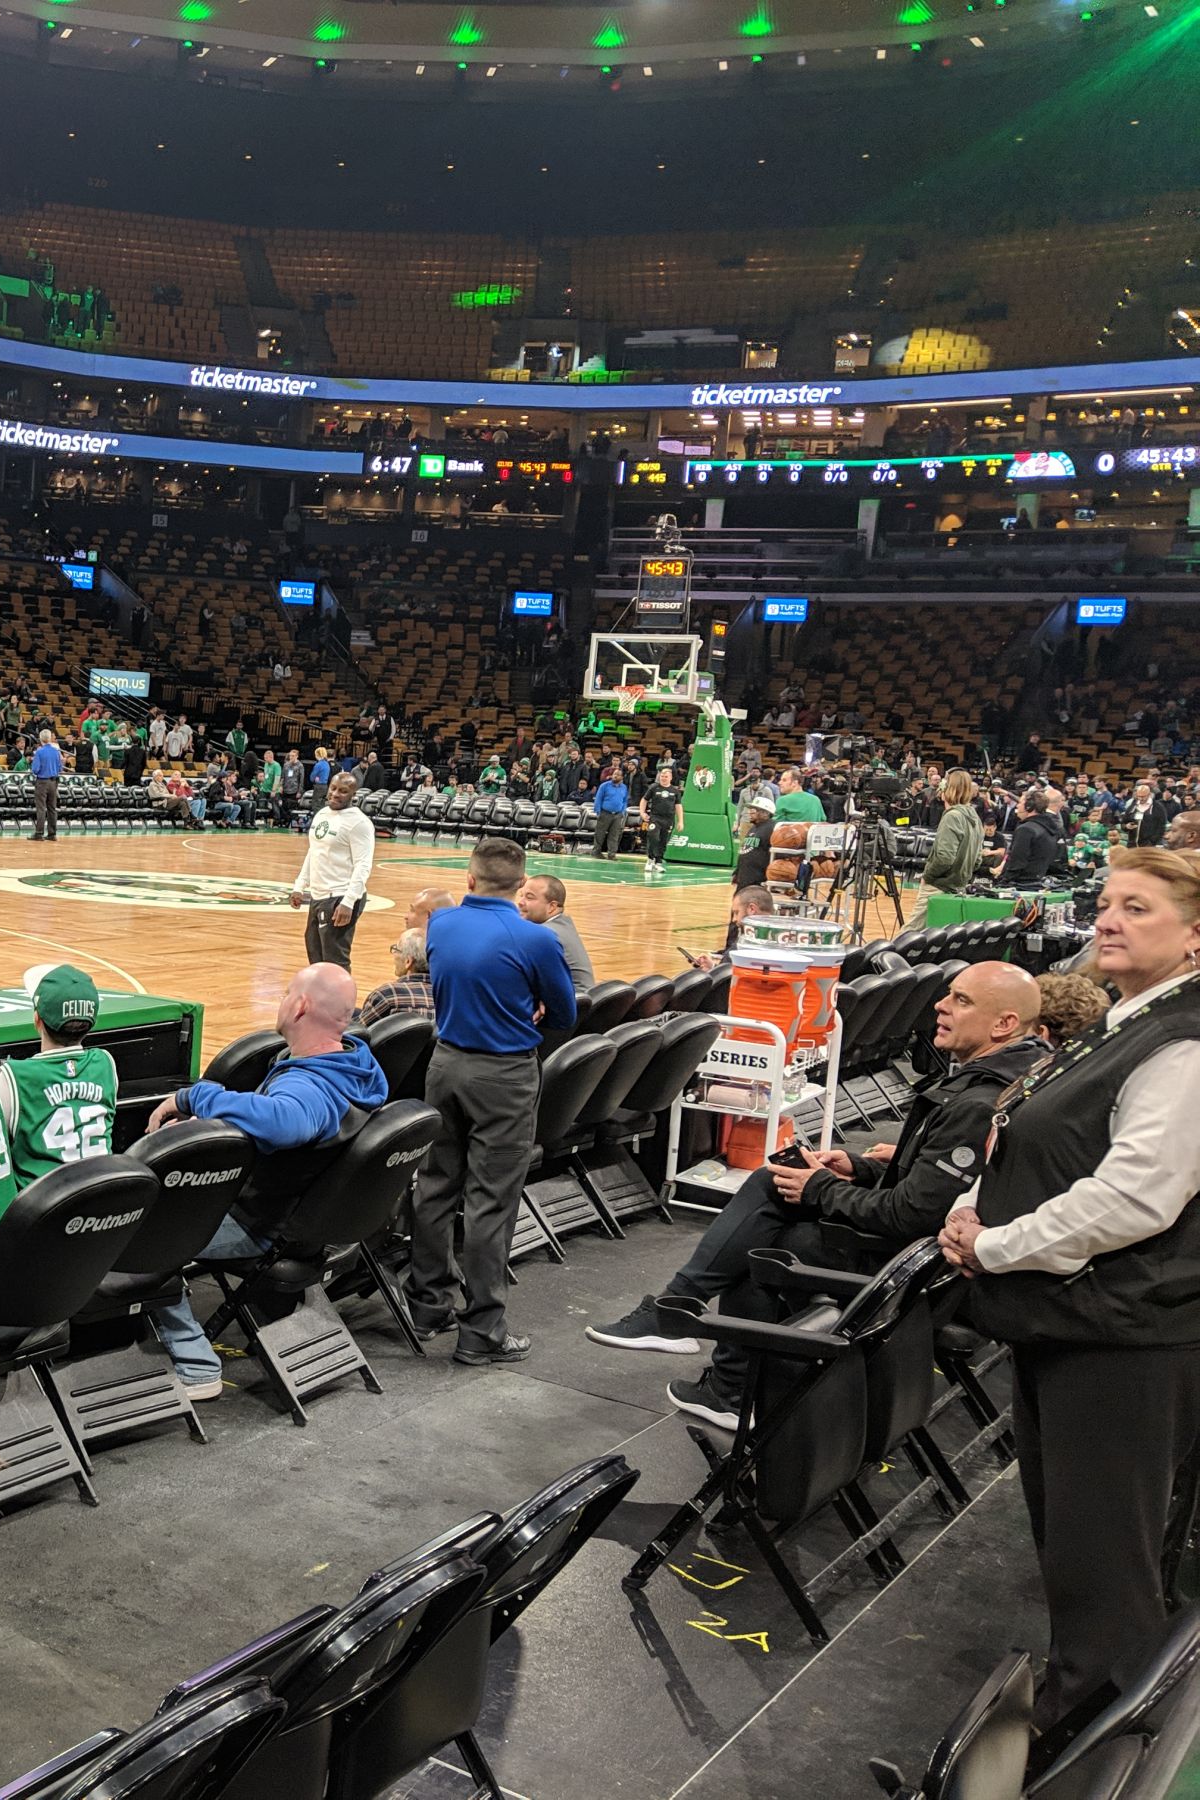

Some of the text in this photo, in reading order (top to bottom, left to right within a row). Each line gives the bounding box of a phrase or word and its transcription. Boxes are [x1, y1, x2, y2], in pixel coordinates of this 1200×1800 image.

[190, 366, 310, 396] ticketmaster
[691, 384, 833, 405] ticketmaster
[371, 455, 412, 473] 6:47
[1098, 454, 1115, 472] 0
[1137, 448, 1196, 463] 45:43
[423, 458, 441, 473] TD
[447, 459, 484, 472] Bank
[519, 462, 546, 473] 45:43
[698, 472, 706, 482] 0
[728, 472, 737, 482] 0
[759, 472, 767, 482] 0
[790, 472, 799, 482] 0
[824, 471, 848, 482] 0/0
[872, 470, 897, 482] 0/0
[926, 468, 936, 479] 0
[964, 467, 973, 477] 7
[988, 467, 997, 476] 0
[725, 463, 743, 471] AST
[757, 463, 773, 471] STL
[789, 463, 803, 471] TO
[827, 463, 845, 471] 3PT
[877, 462, 890, 470] FG
[921, 460, 944, 468] FG%
[1151, 463, 1172, 471] QTR
[646, 561, 684, 576] 45:43
[292, 587, 312, 595] TUFTS
[93, 676, 146, 690] zoom.us
[62, 1000, 96, 1018] CELTICS
[710, 1050, 769, 1069] SERIES
[44, 1081, 103, 1106] HORFORD
[42, 1104, 109, 1163] 42
[179, 1166, 242, 1188] Putnam
[80, 1207, 145, 1235] Putnam
